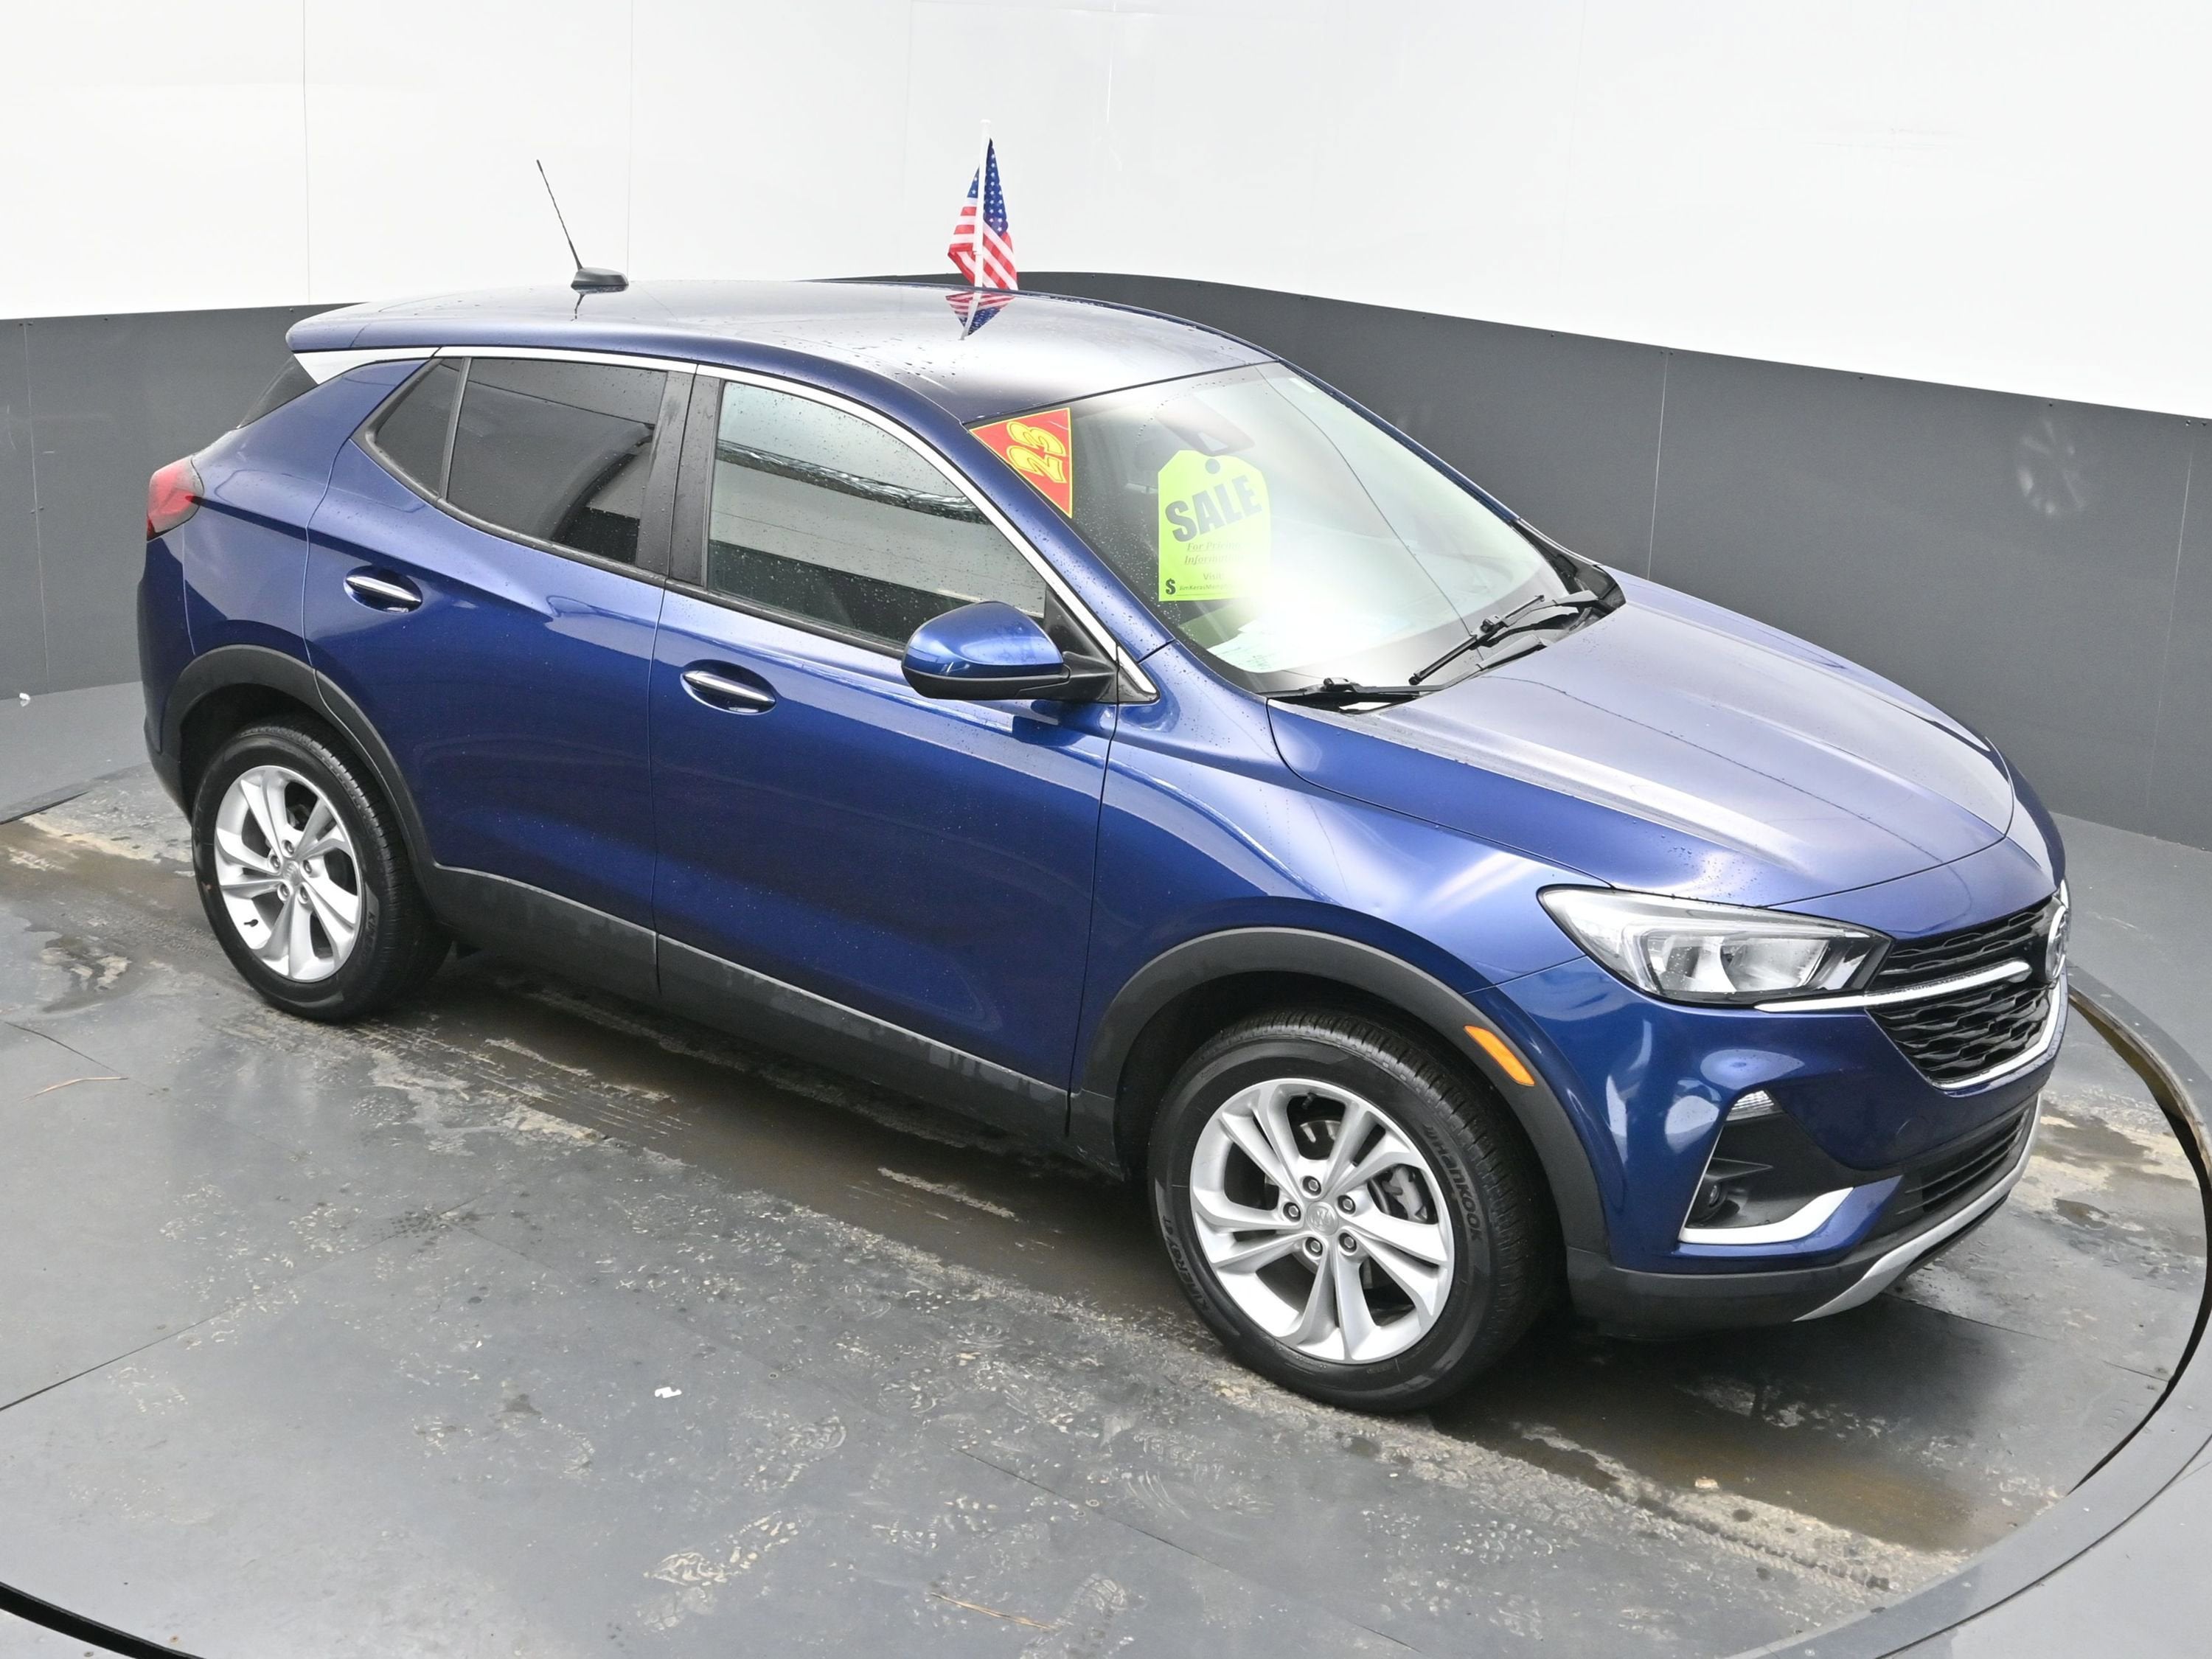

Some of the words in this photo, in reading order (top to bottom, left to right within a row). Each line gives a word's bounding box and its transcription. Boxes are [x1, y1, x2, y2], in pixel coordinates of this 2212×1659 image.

[1006, 421, 1067, 483] 23
[1165, 475, 1262, 542] SALE
[1186, 542, 1205, 552] For
[1166, 578, 1176, 594] $
